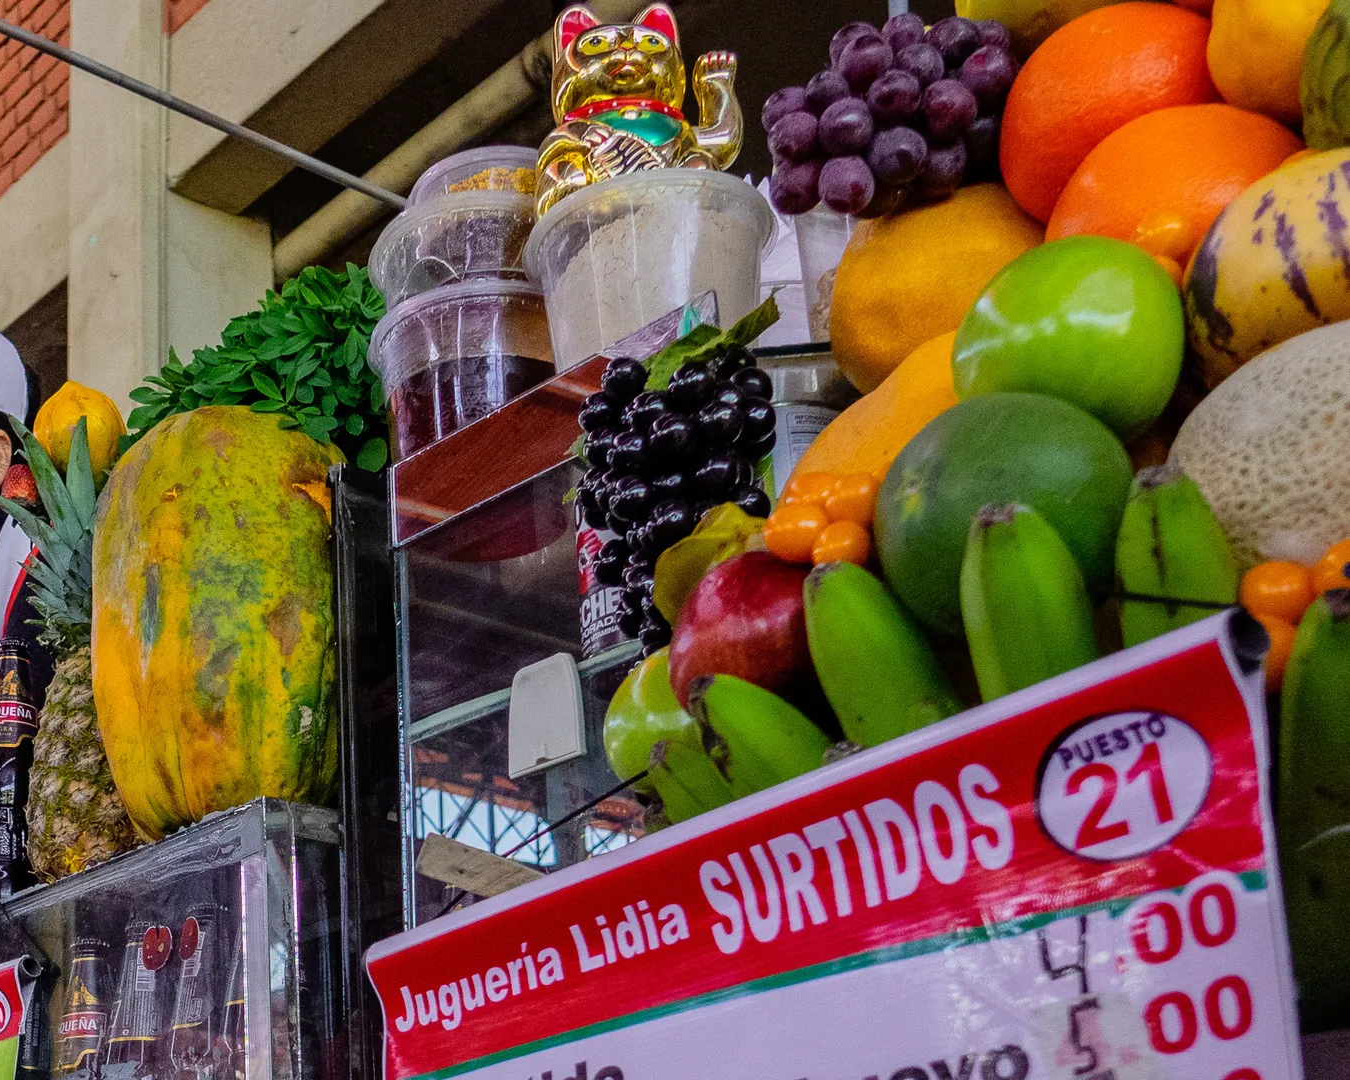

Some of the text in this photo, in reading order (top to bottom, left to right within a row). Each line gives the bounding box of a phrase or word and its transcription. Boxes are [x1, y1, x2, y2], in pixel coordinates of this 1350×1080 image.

[1057, 713, 1166, 770] PUESTO
[1065, 741, 1177, 852] 21
[395, 764, 1015, 1032] Juguería Lidia SURTIDOS
